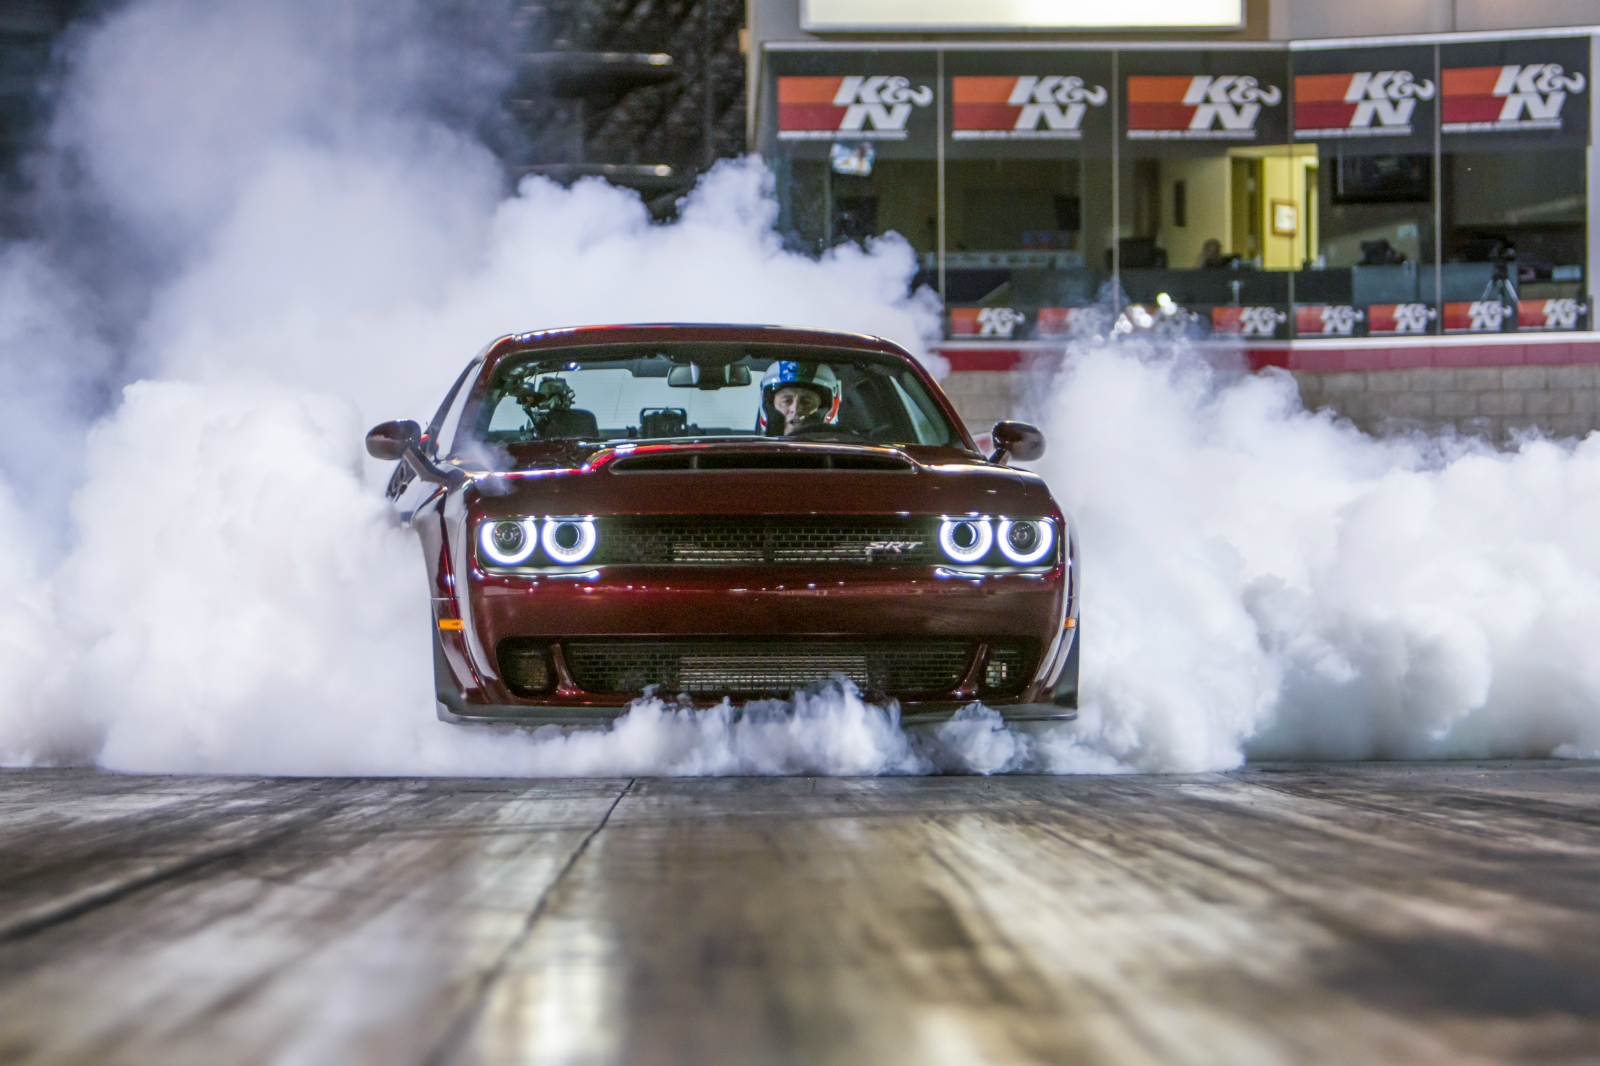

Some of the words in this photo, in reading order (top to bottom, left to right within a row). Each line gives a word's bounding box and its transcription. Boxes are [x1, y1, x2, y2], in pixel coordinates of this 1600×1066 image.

[833, 76, 933, 129] K&N
[1007, 76, 1108, 129] K&N
[1182, 75, 1282, 129] K&N
[1344, 70, 1435, 127] K&N
[1492, 63, 1586, 120] K&N
[865, 541, 923, 552] SRT
